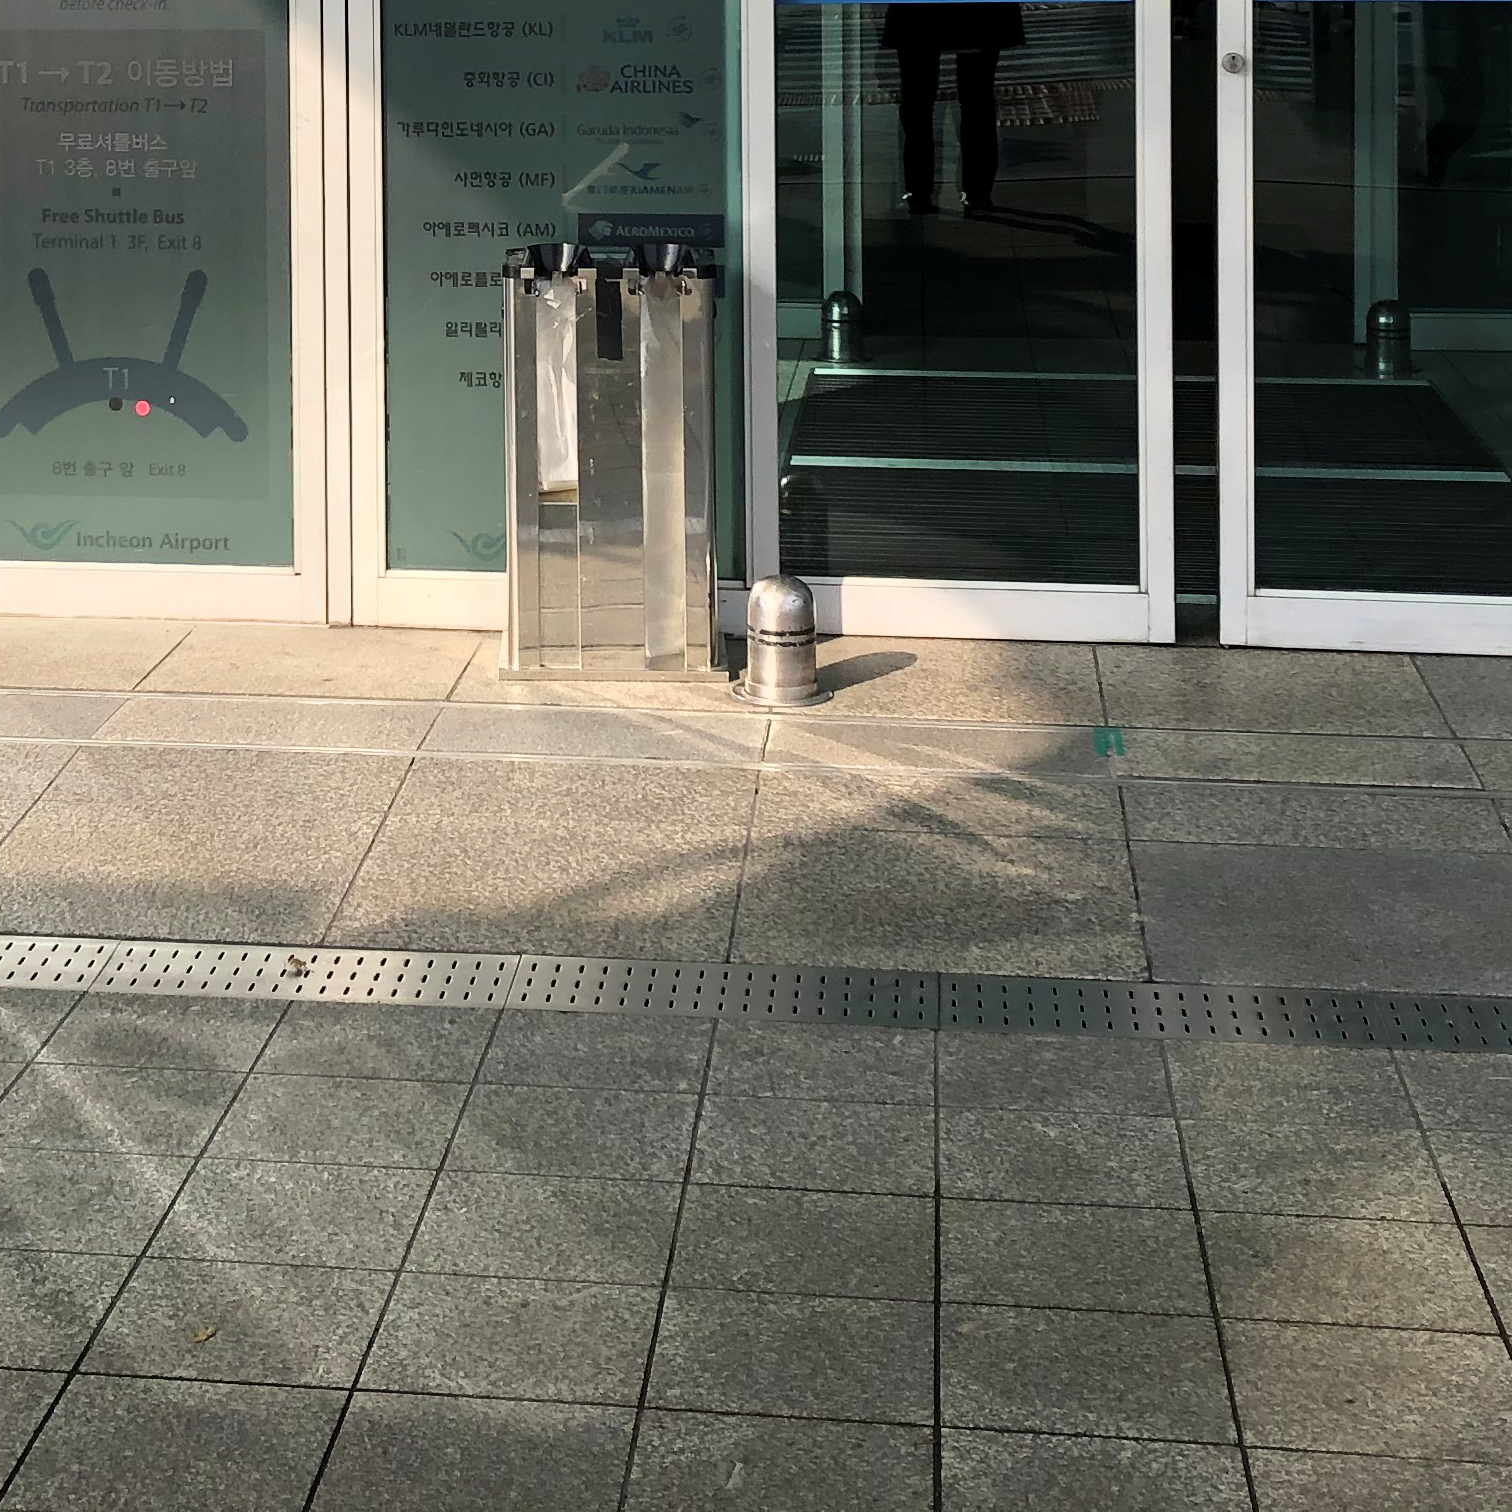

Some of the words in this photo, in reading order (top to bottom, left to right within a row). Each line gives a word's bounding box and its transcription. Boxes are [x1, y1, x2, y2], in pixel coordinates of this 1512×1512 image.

[521, 21, 554, 38] (KL)
[76, 60, 113, 85] T2
[620, 63, 682, 79] CHINA
[609, 78, 694, 94] AIRLINES
[21, 97, 139, 116] Transportation
[519, 121, 555, 138] (GA)
[519, 171, 555, 189] (MF)
[42, 208, 80, 224] Free
[84, 207, 149, 224] Shuttle
[153, 209, 184, 225] Bus
[516, 221, 556, 238] (AM)
[32, 232, 103, 249] Terminal
[157, 235, 188, 250] Exit
[430, 272, 503, 288] 아에로플로
[445, 321, 502, 338] 알리탈리
[102, 367, 130, 390] T1
[459, 372, 503, 388] 체코항
[149, 462, 174, 477] Exit
[77, 530, 152, 549] Incheon
[159, 533, 231, 553] Airport
